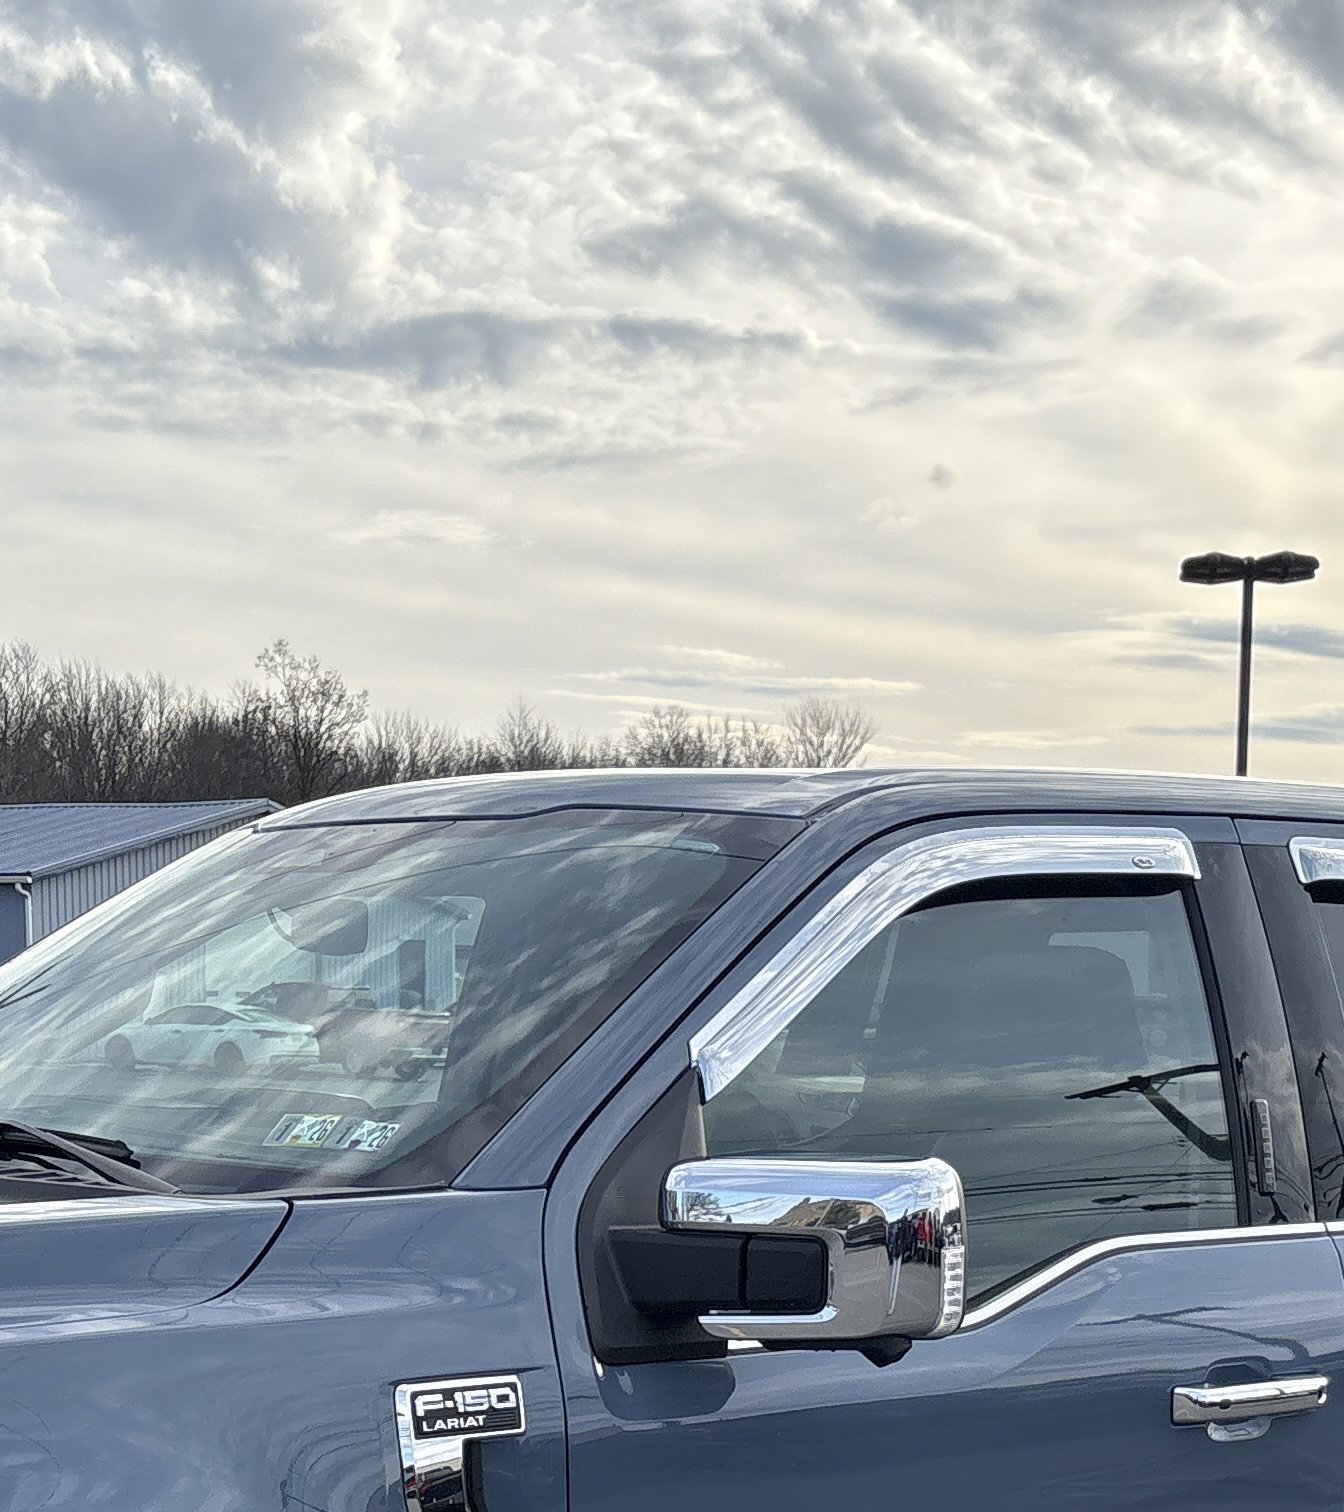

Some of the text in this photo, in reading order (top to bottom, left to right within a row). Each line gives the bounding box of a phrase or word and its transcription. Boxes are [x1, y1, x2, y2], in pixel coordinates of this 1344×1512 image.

[307, 1119, 336, 1142] 26
[367, 1125, 396, 1148] 26
[415, 1387, 517, 1416] F-150
[422, 1415, 487, 1432] LARIAT
